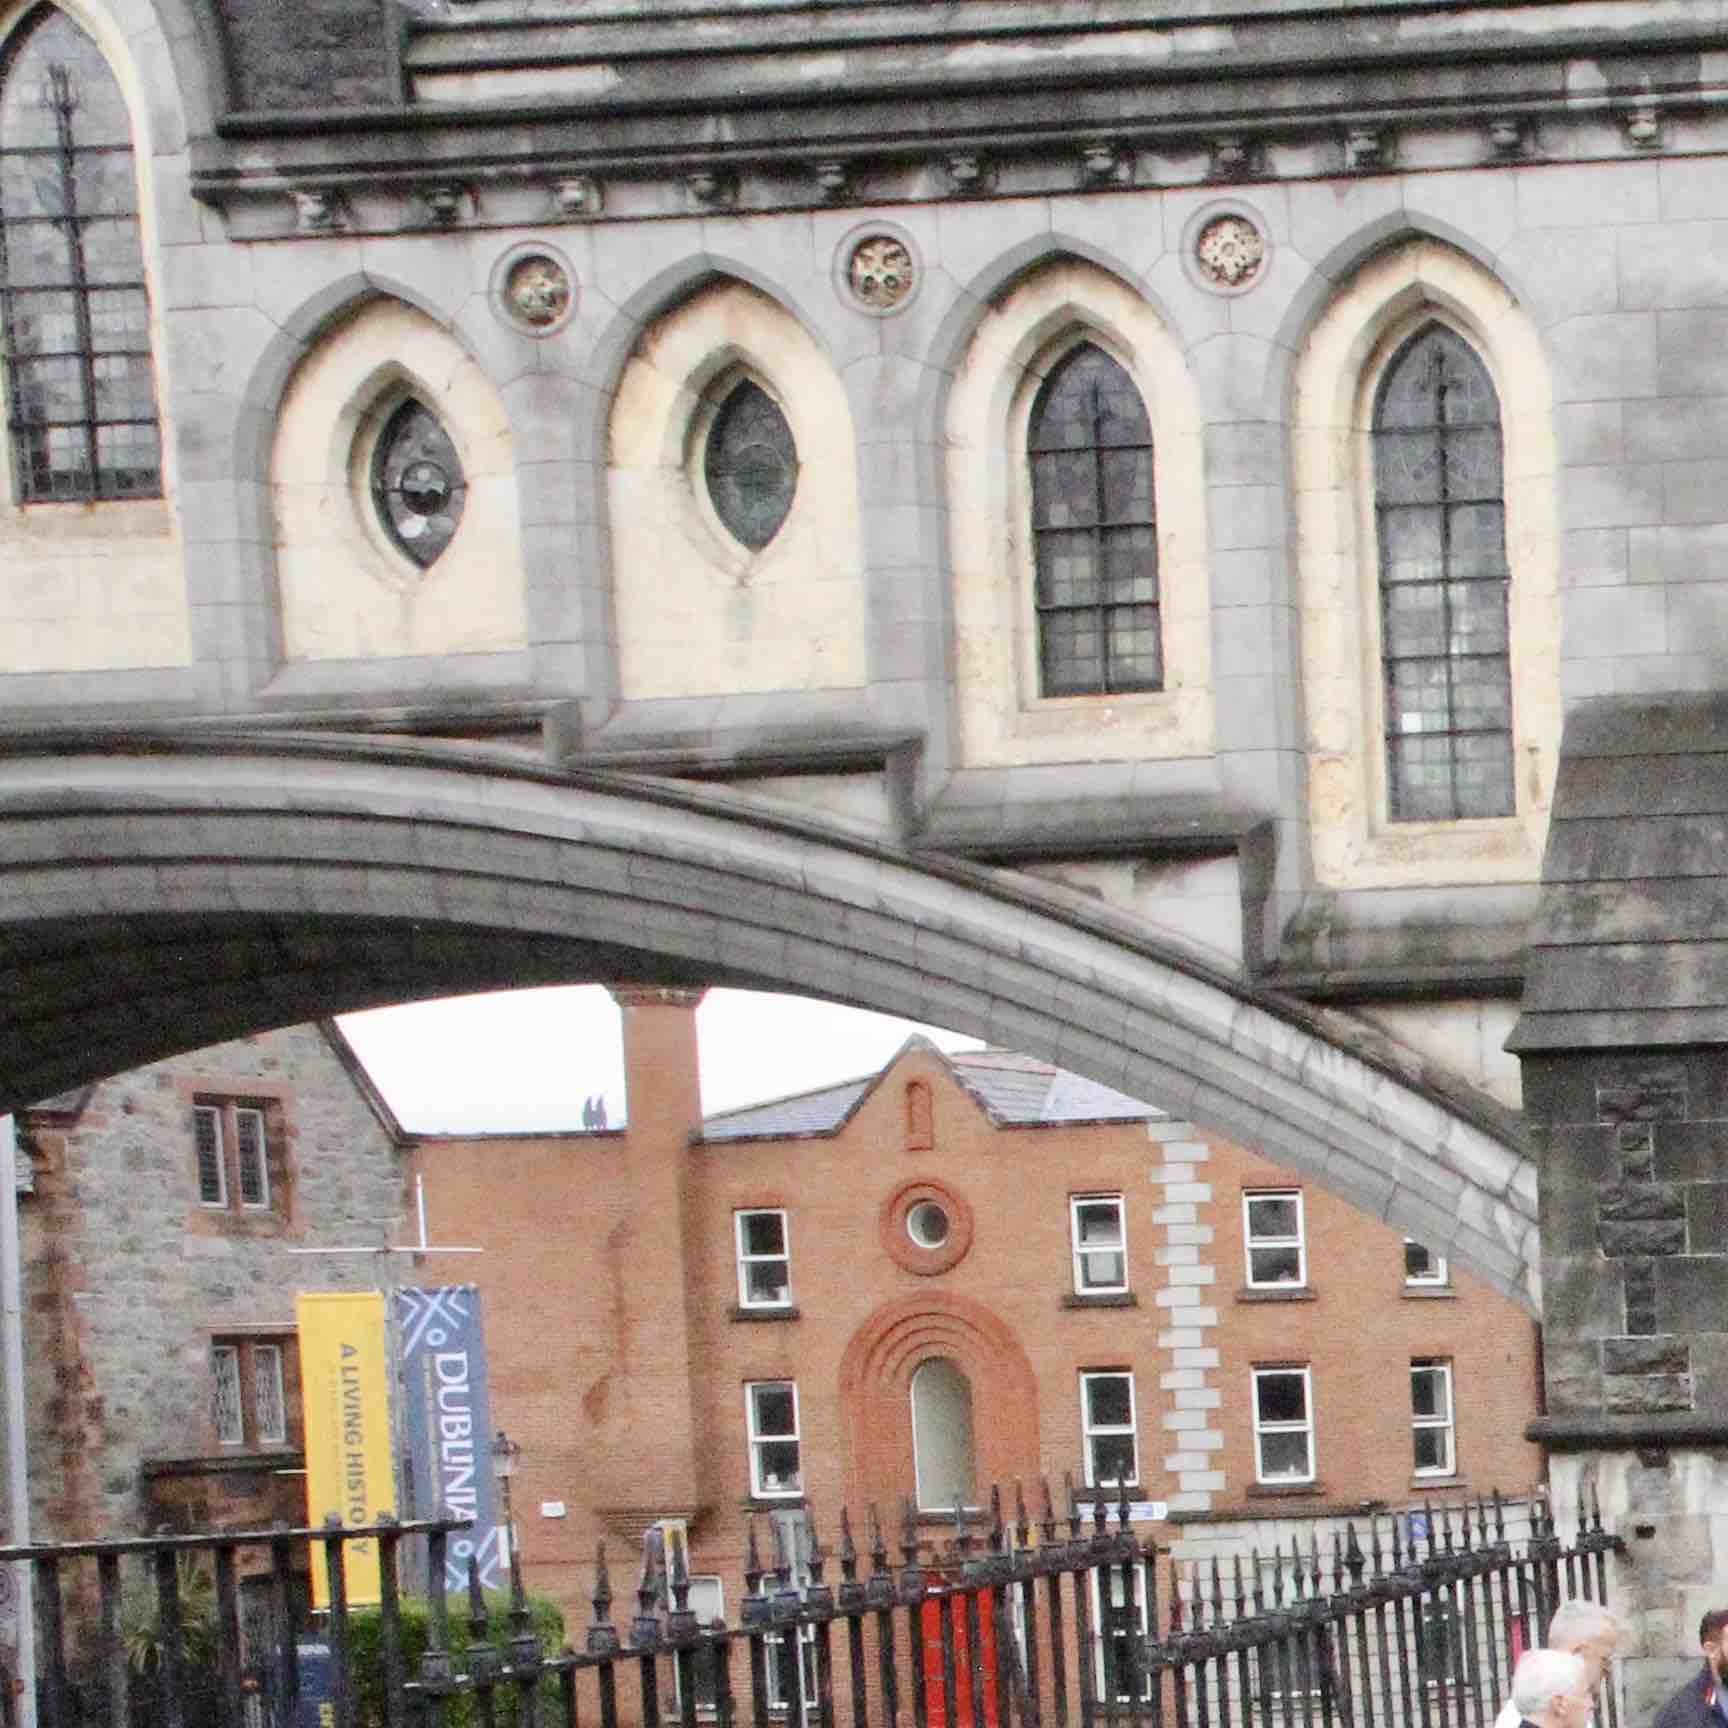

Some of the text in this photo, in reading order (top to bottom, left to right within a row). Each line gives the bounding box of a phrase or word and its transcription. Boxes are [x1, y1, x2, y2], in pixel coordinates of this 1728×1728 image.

[340, 1342, 368, 1556] A LIVING HISTOY
[434, 1351, 477, 1521] DUBLINIA
